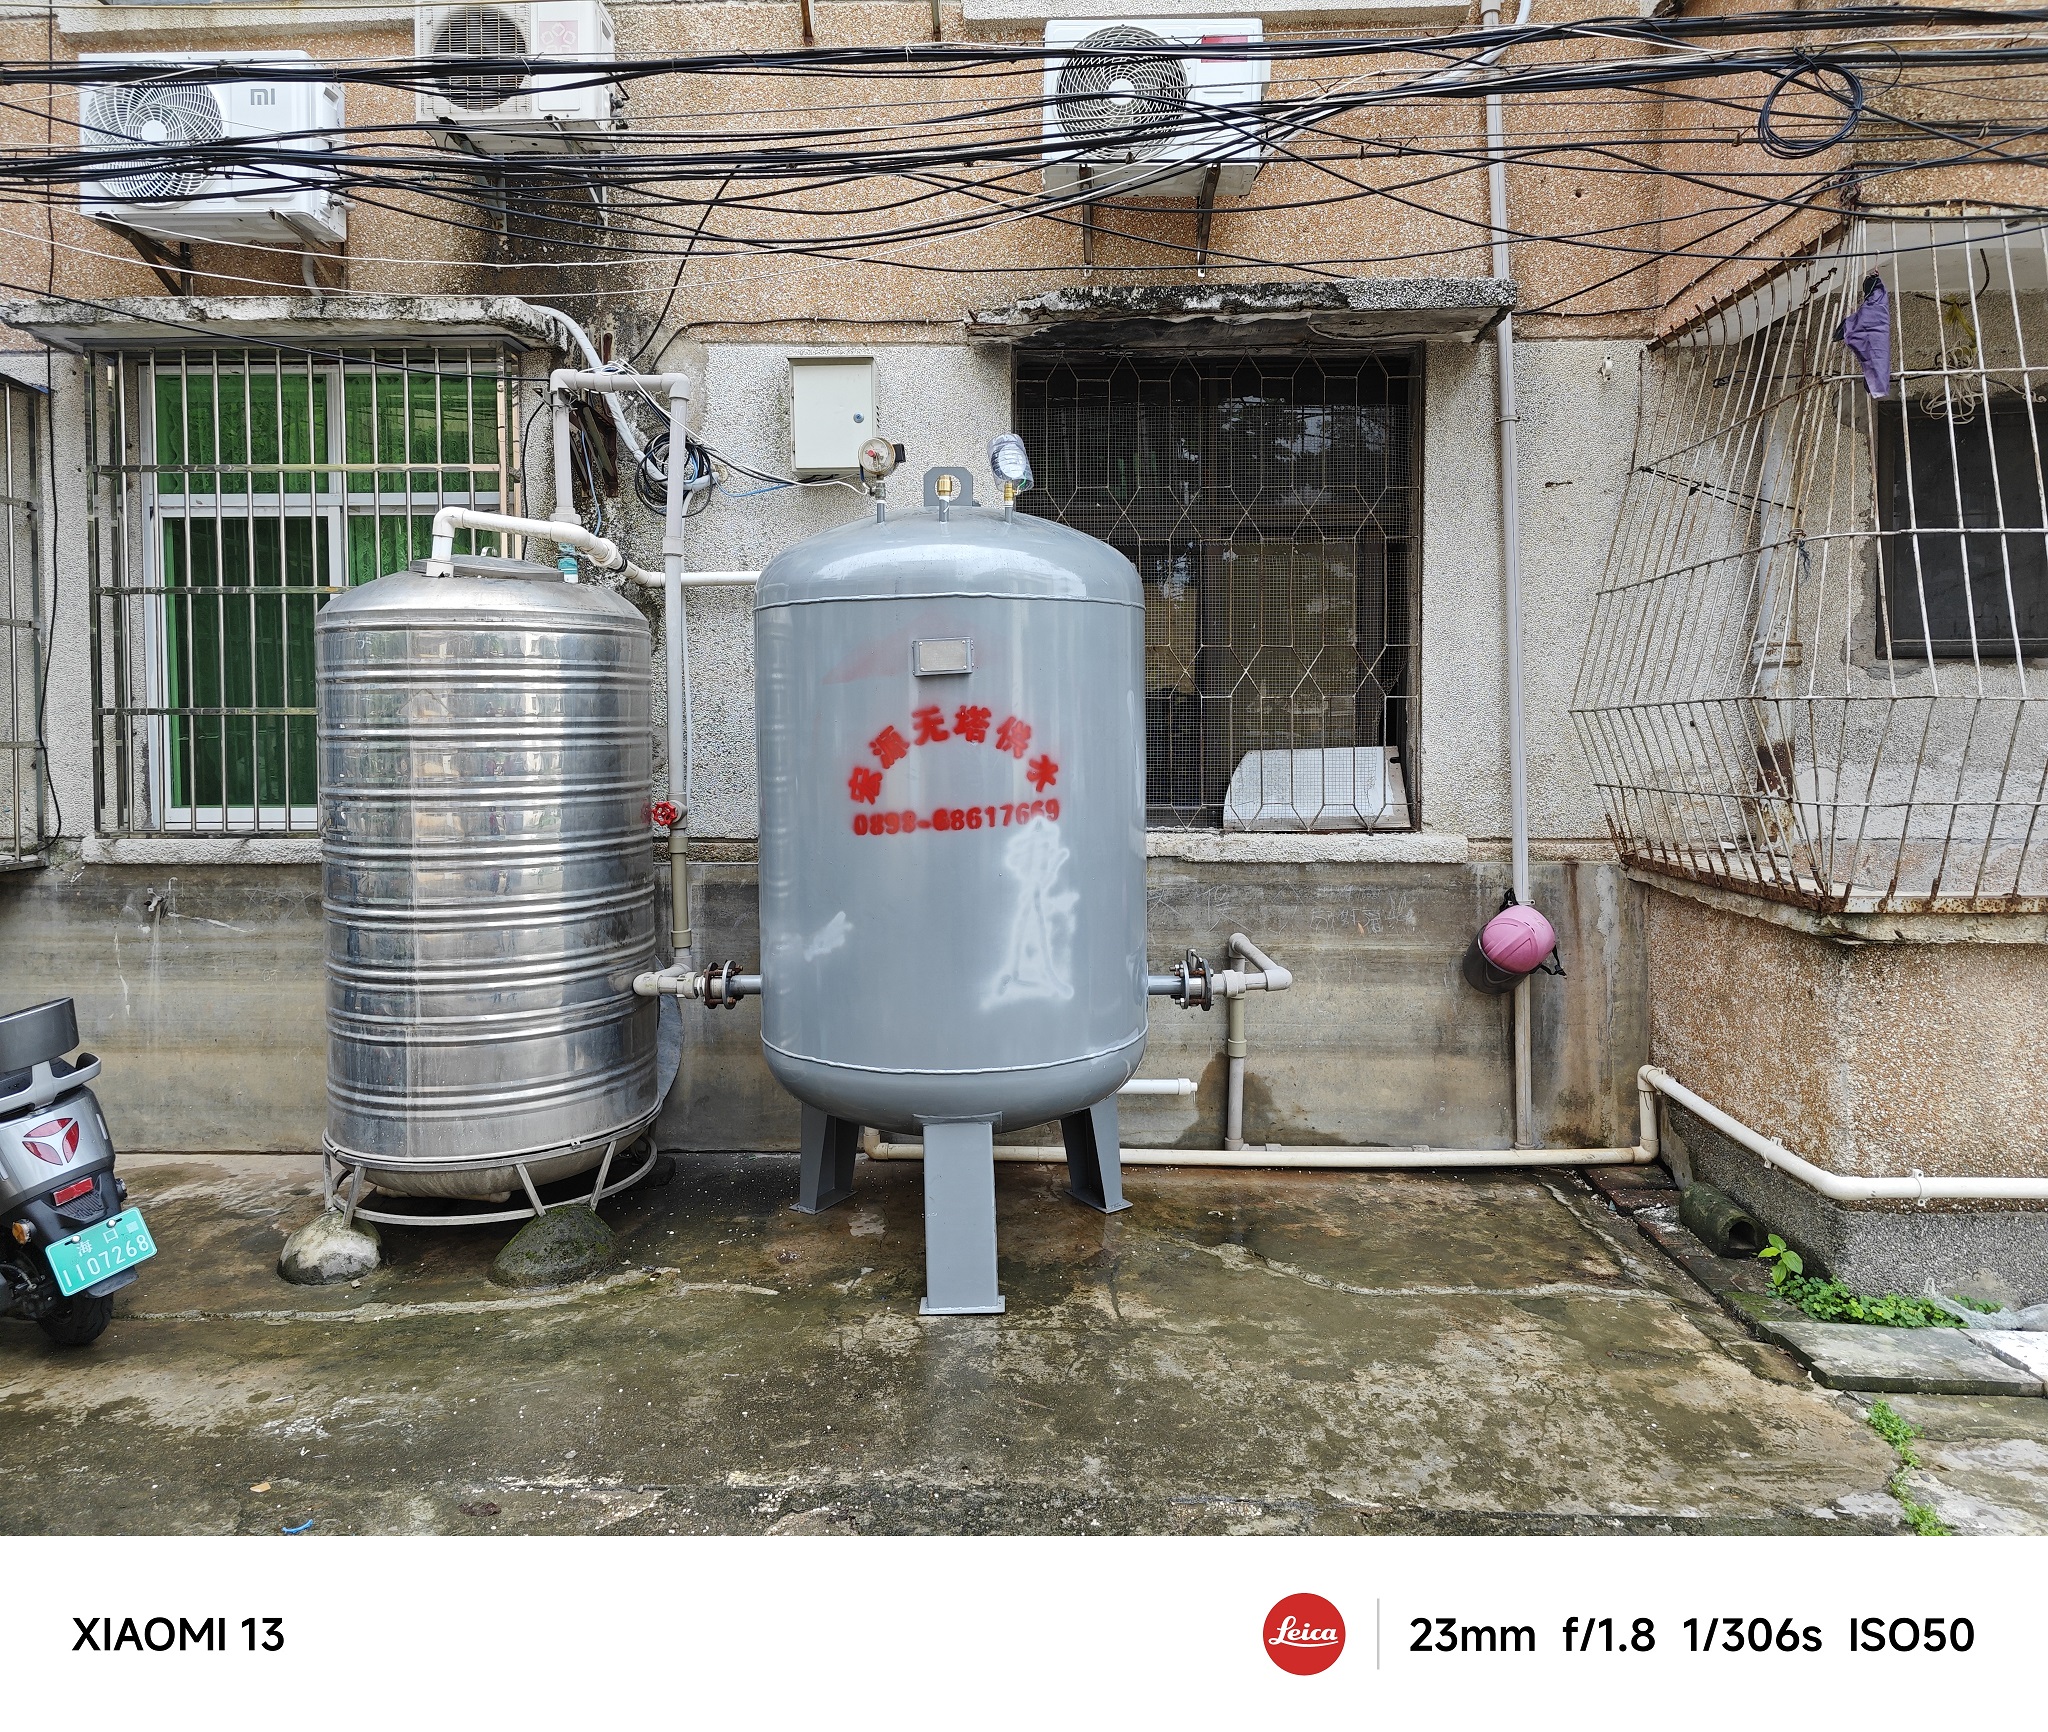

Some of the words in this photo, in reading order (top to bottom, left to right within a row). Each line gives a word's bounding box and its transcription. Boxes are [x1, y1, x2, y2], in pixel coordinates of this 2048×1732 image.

[849, 705, 1059, 805] 宏源无塔供水
[62, 1234, 149, 1288] 1107268
